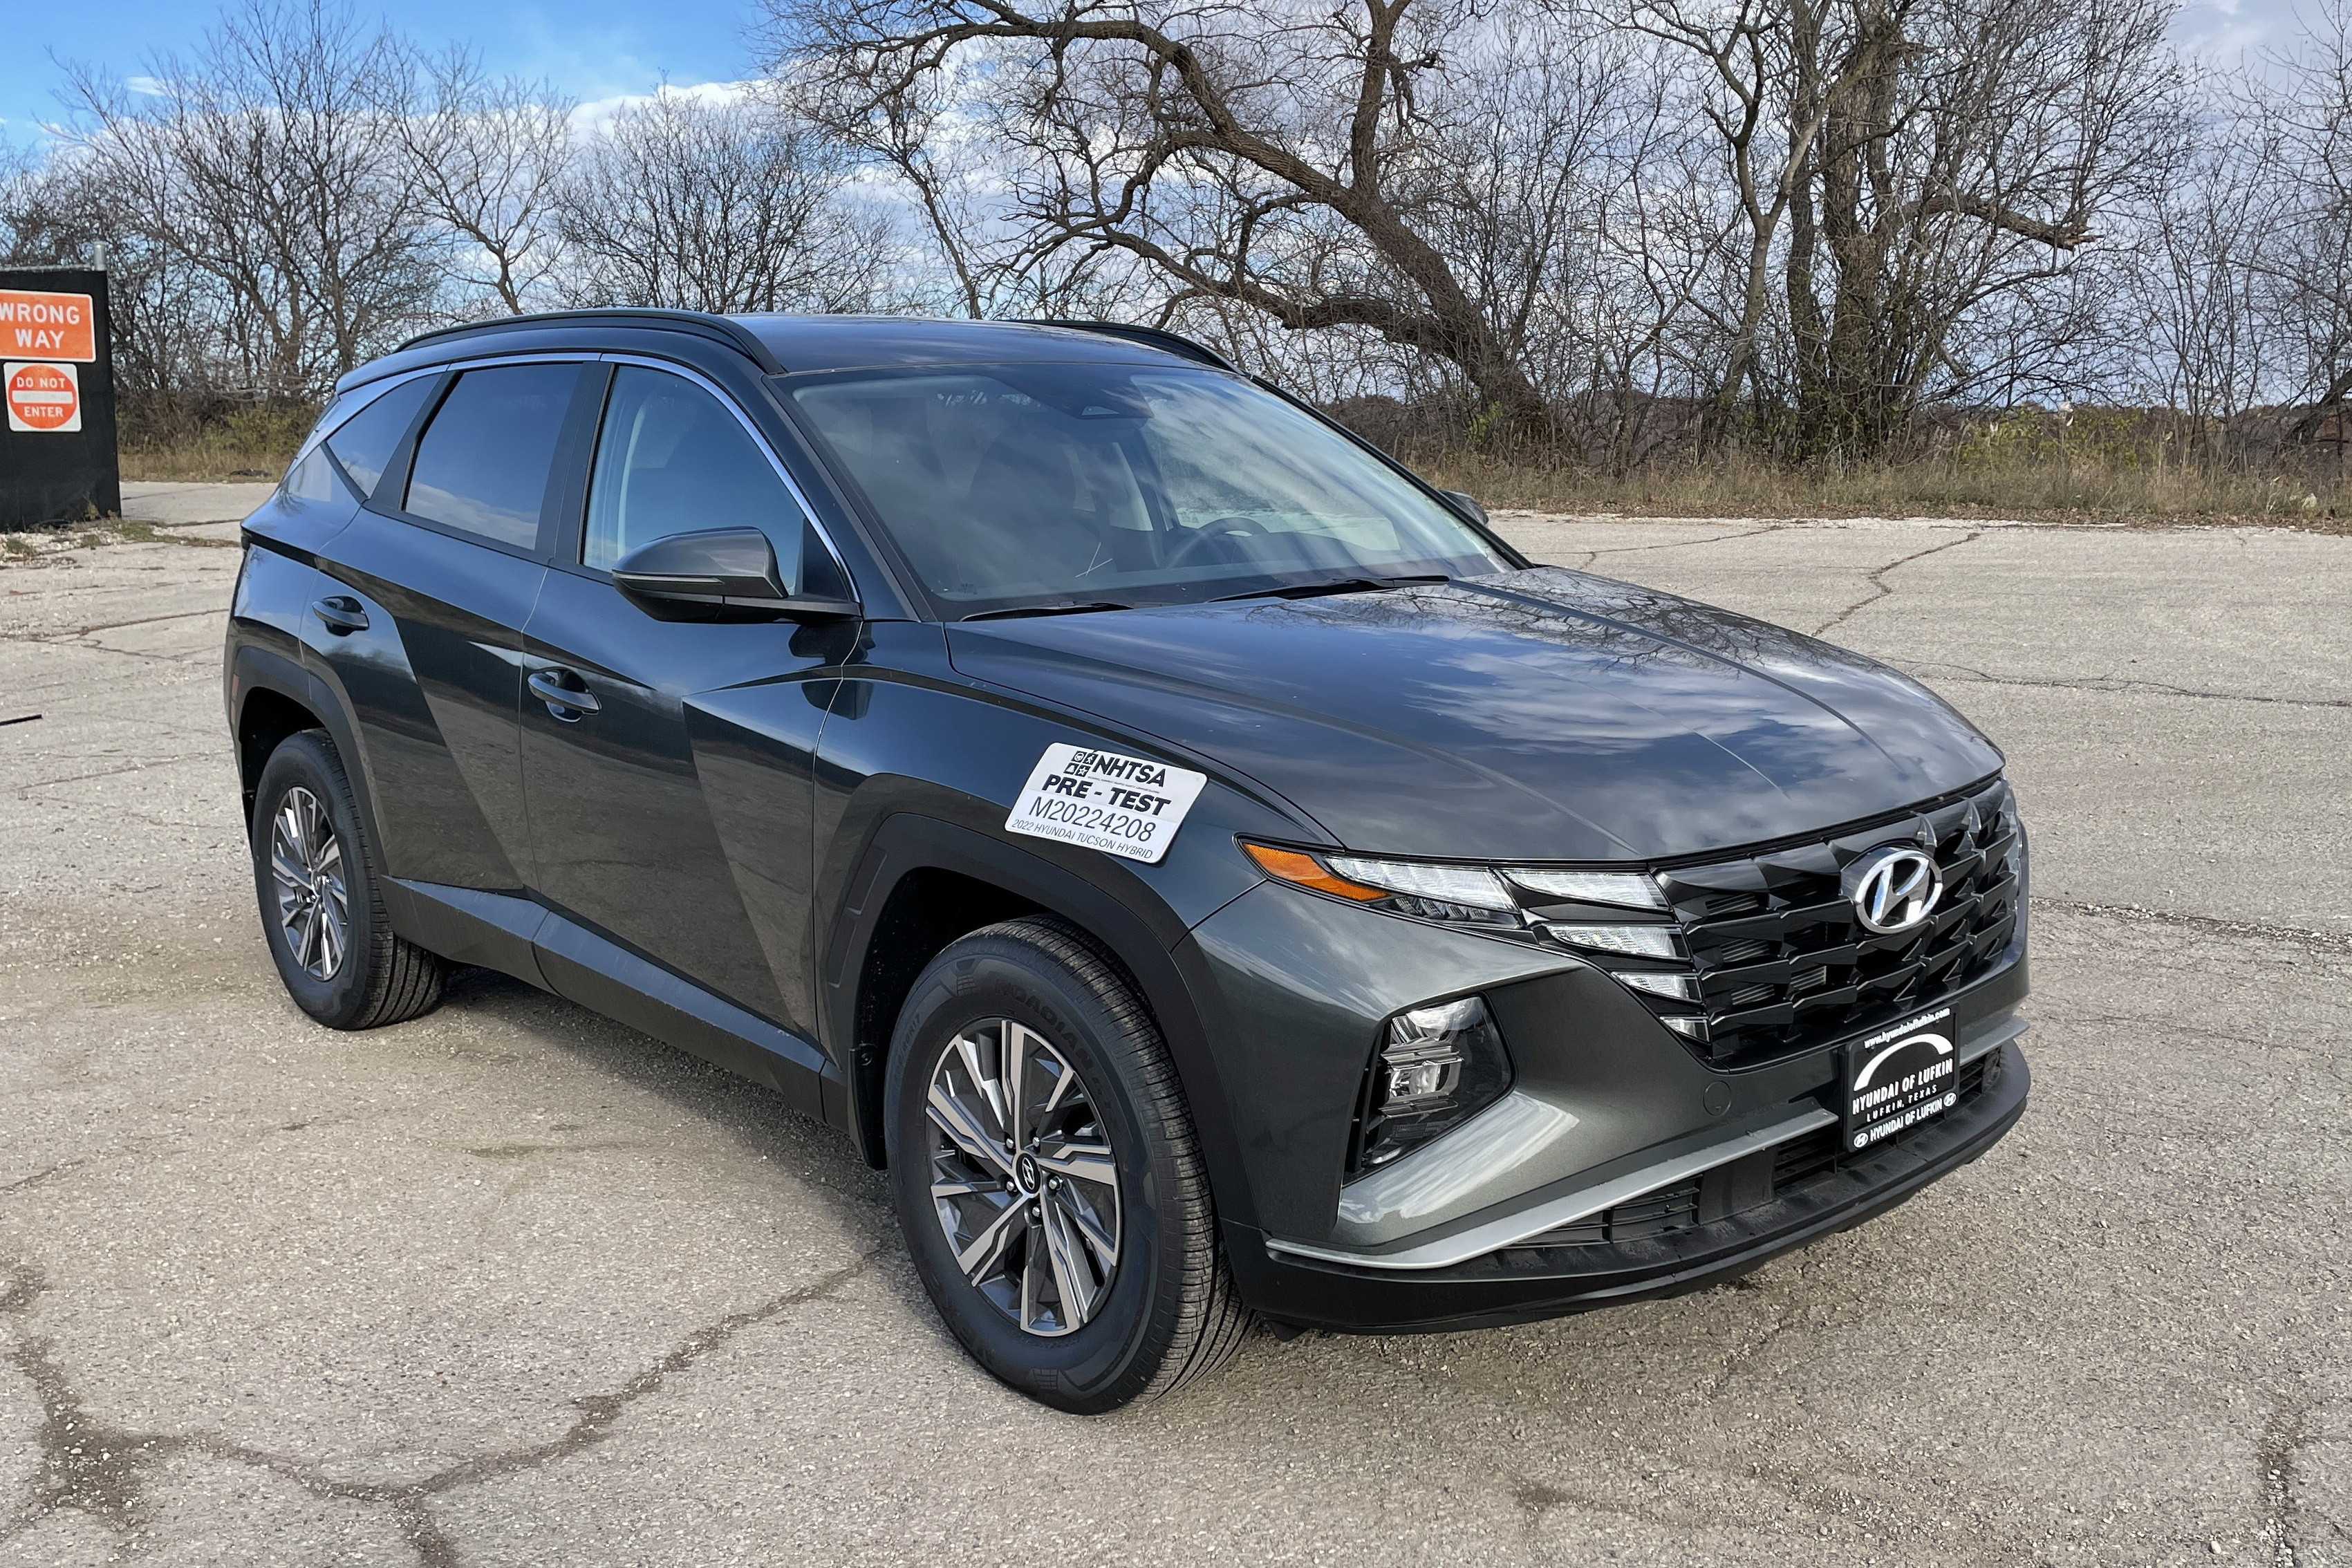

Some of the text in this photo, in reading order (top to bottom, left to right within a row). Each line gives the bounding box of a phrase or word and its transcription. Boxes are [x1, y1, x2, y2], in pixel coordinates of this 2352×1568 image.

[0, 302, 80, 325] WRONG
[15, 328, 65, 348] WAY
[17, 377, 66, 389] DO NOT
[24, 406, 64, 418] ENTER
[1092, 754, 1166, 787] NHTSA
[1042, 774, 1093, 799] PRE
[1108, 787, 1171, 816] TEST
[1029, 796, 1157, 842] M20224208
[1011, 819, 1153, 859] 2022 HYUNDAI TUCSON HYBRID
[1853, 1058, 1952, 1114] HYUNDAI OF LUFKIN
[1908, 1085, 1937, 1103] TEXAS
[1869, 1098, 1942, 1141] HYUNDAI OF LUFKIN
